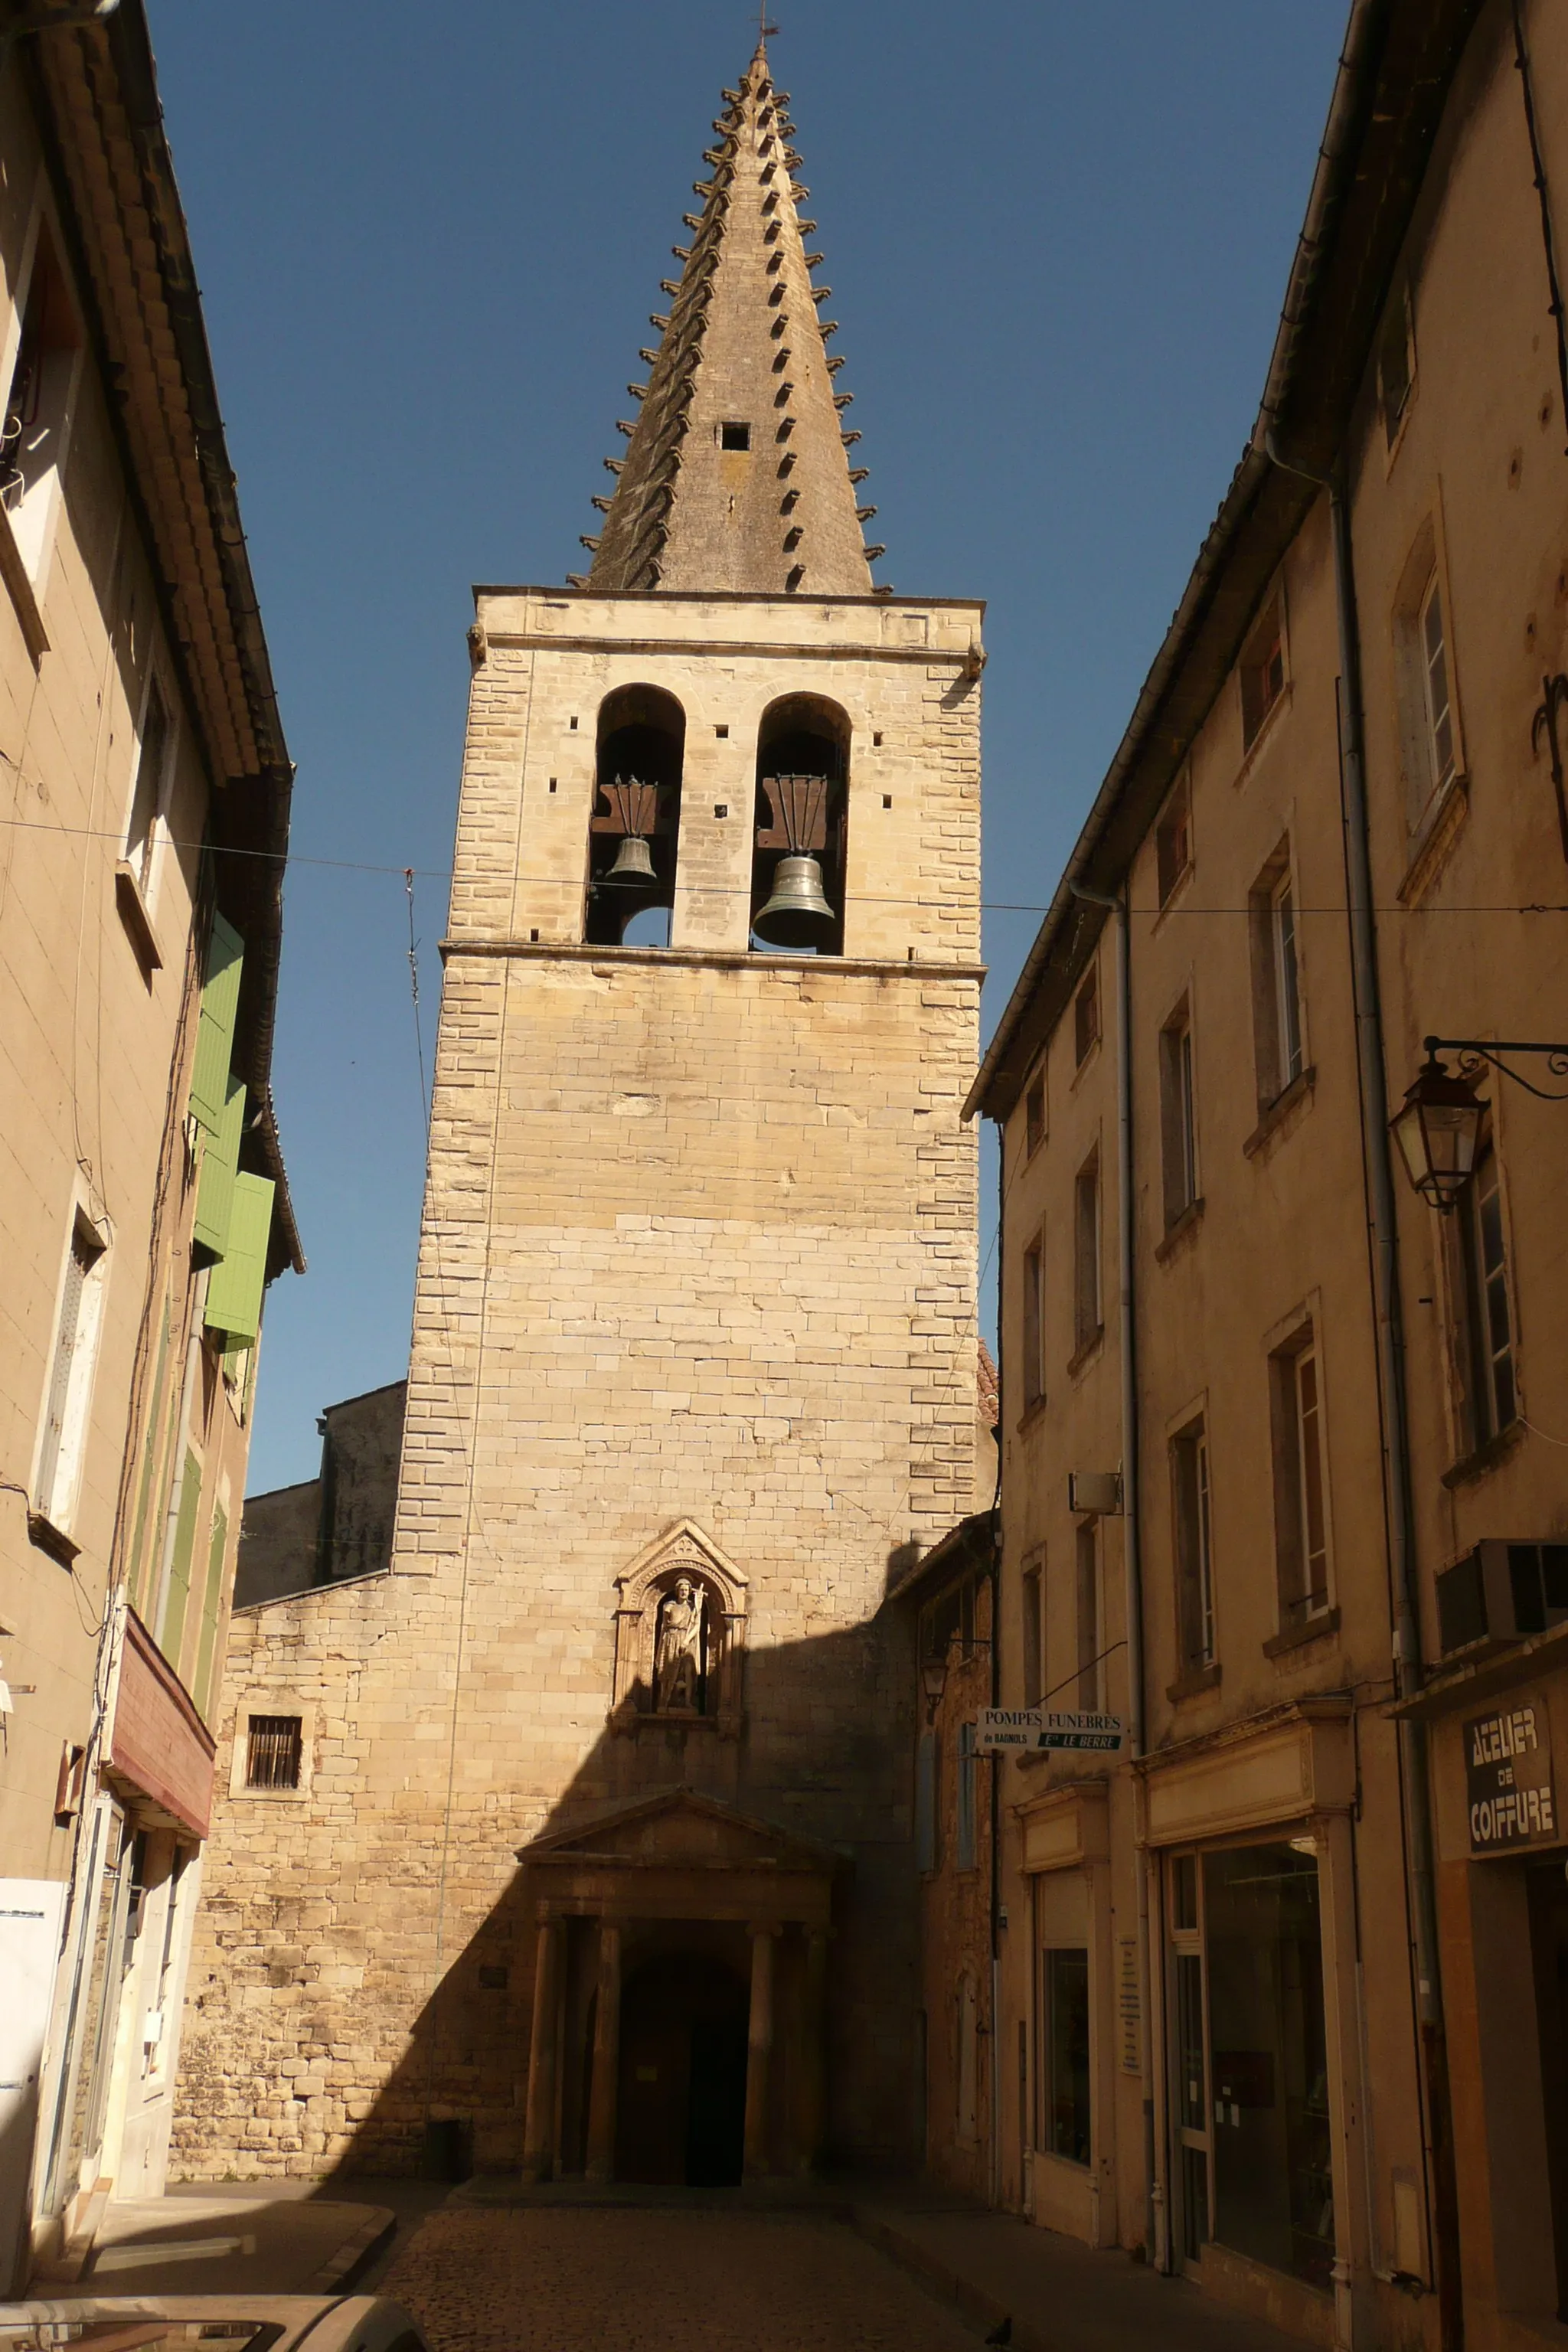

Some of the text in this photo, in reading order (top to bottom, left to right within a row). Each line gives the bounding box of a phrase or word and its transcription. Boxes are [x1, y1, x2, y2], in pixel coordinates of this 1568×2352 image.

[985, 1711, 1042, 1726] POMPES
[995, 1733, 1027, 1744] BAGNOLS
[1063, 1735, 1076, 1746] LE
[1079, 1736, 1115, 1749] BERRE
[1472, 1708, 1537, 1767] ATELIER
[1498, 1767, 1514, 1787] DE
[1471, 1786, 1553, 1842] COIFFURE
